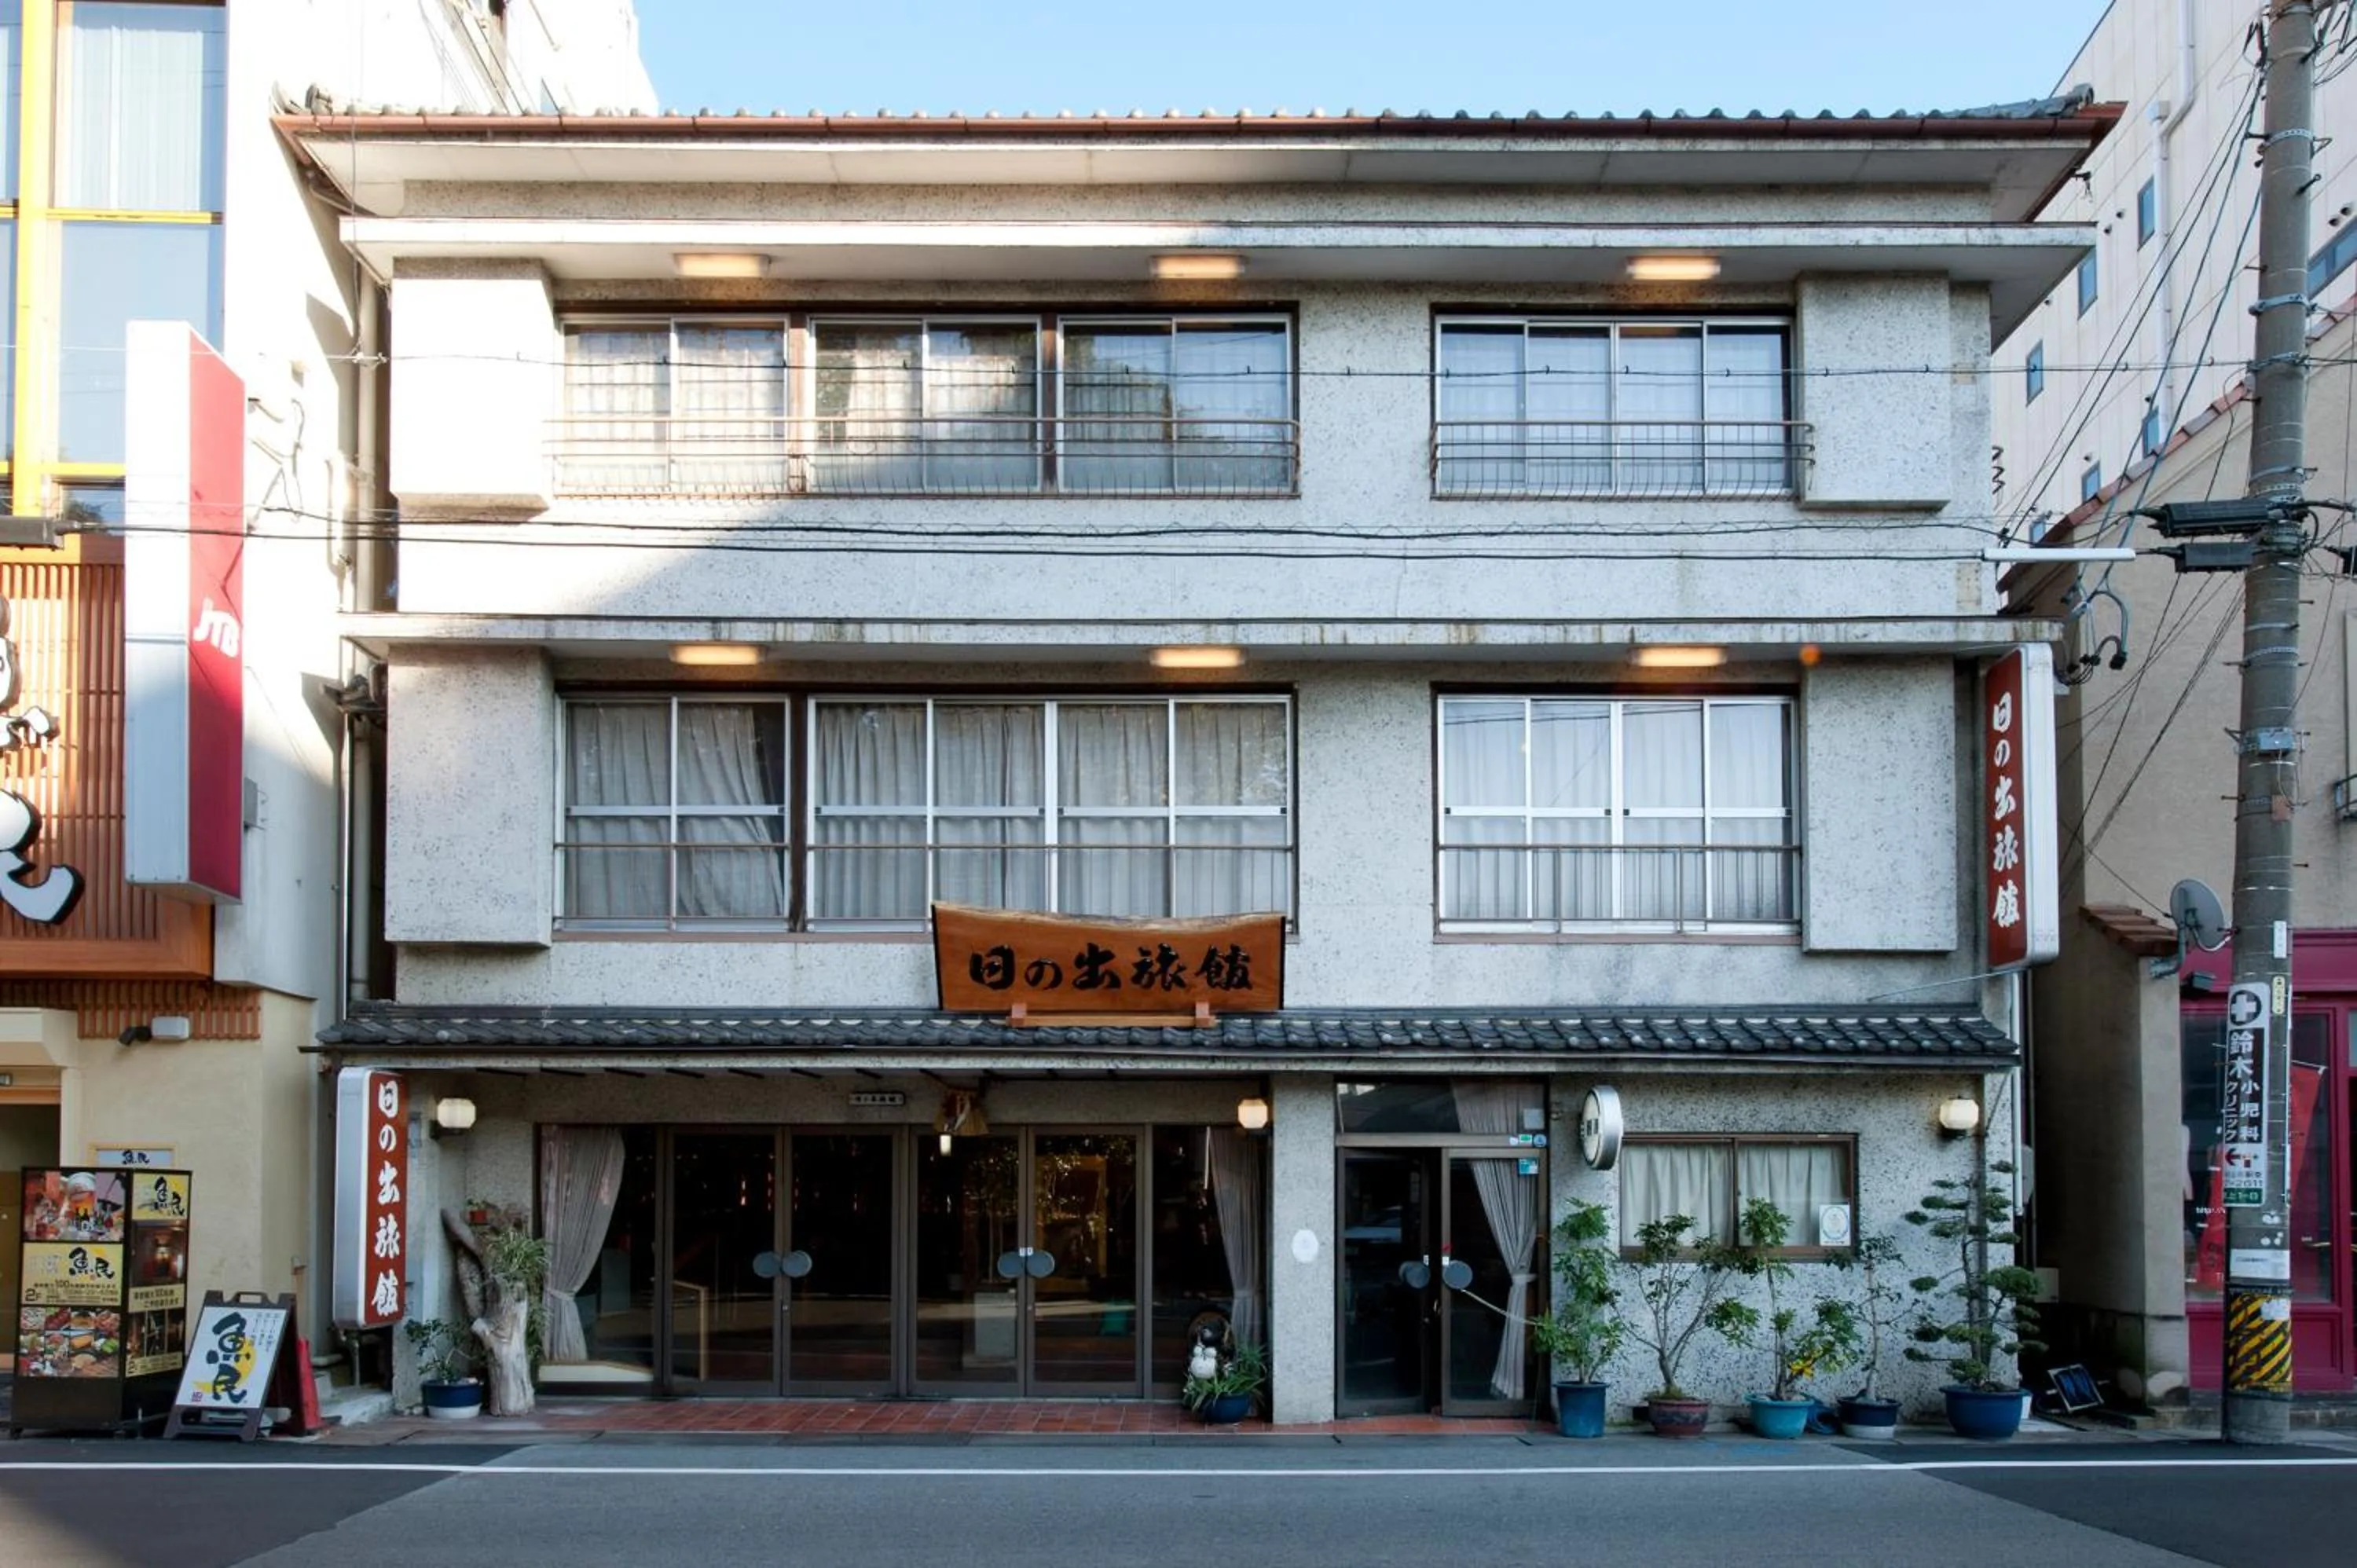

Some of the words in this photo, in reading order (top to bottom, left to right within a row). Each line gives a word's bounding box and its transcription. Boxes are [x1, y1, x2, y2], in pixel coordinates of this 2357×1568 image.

[192, 596, 240, 658] JTB
[1991, 691, 2020, 929] 日の出旅館
[969, 943, 1254, 991] 日の出旅館
[2224, 1081, 2238, 1141] クリニック
[2240, 1079, 2260, 1141] 小児科
[122, 1149, 150, 1164] 魚民
[154, 1176, 185, 1216] 魚民
[372, 1080, 400, 1317] 日の出旅館
[68, 1246, 115, 1280] 魚民
[206, 1311, 251, 1404] 魚民
